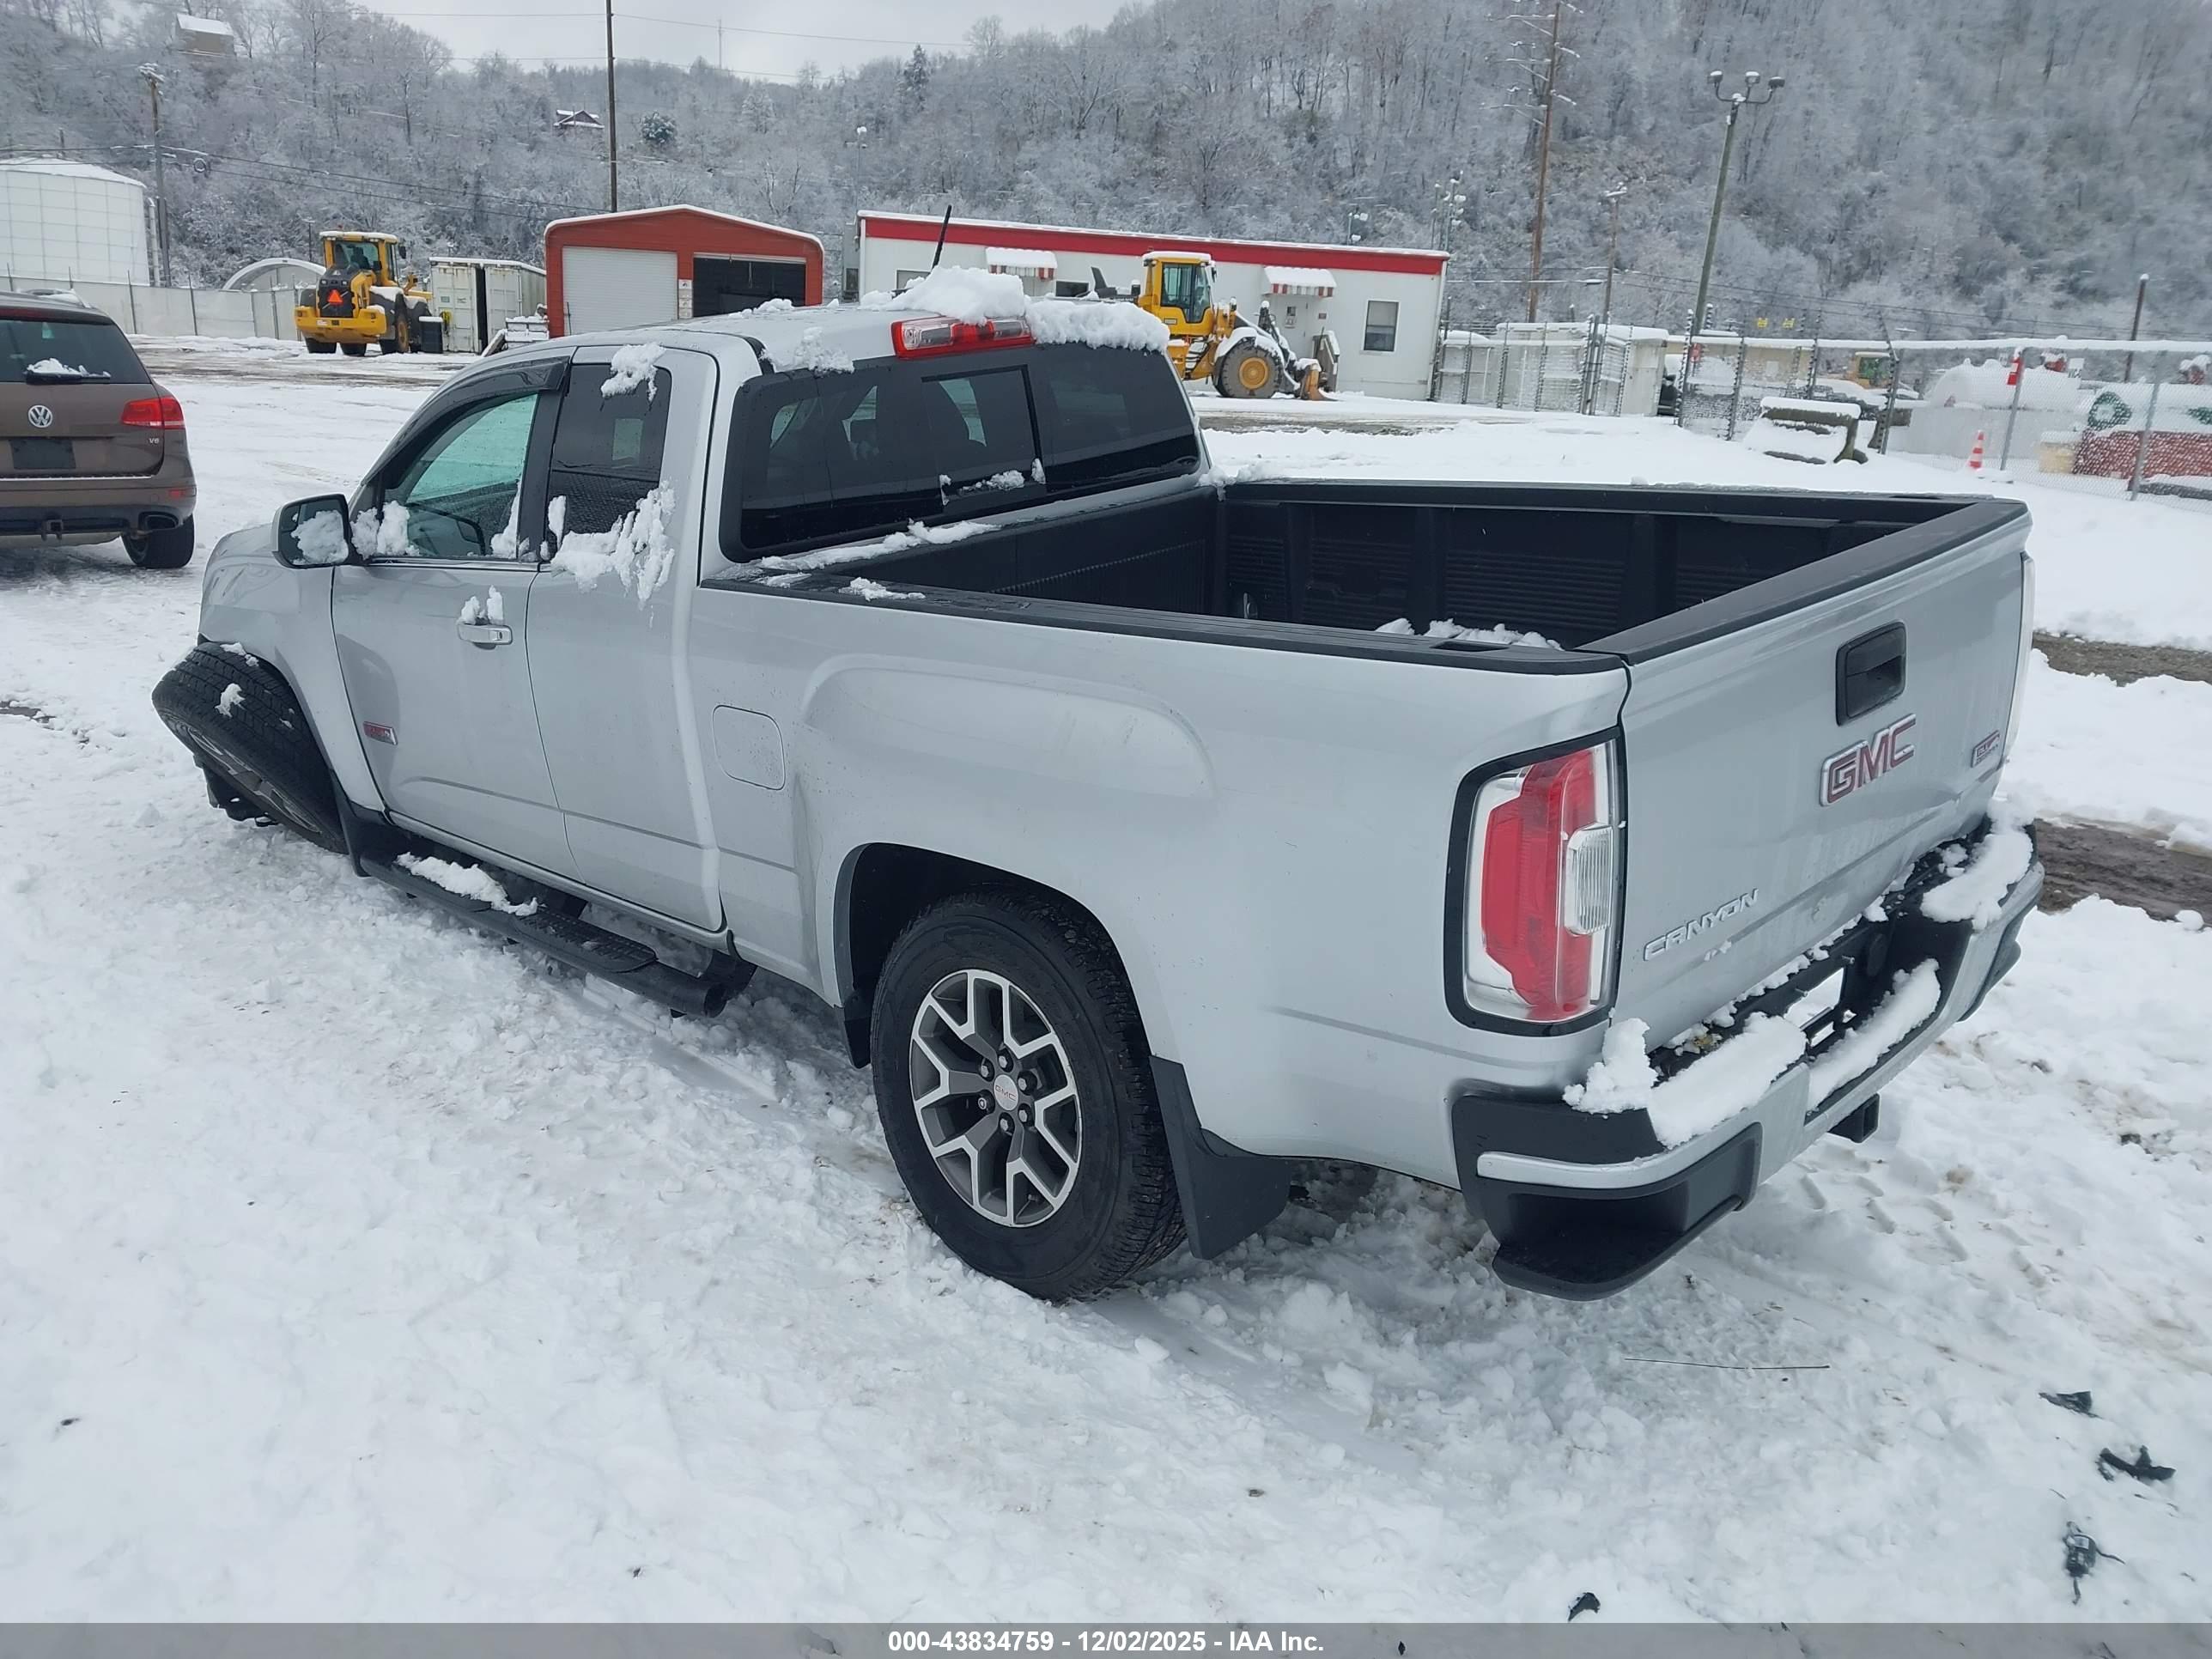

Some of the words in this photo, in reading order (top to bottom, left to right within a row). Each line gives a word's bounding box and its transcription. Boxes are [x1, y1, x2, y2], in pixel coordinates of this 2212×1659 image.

[1820, 713, 1917, 807] GMC
[1643, 887, 1759, 962] CANYON
[995, 1085, 1018, 1102] GMC
